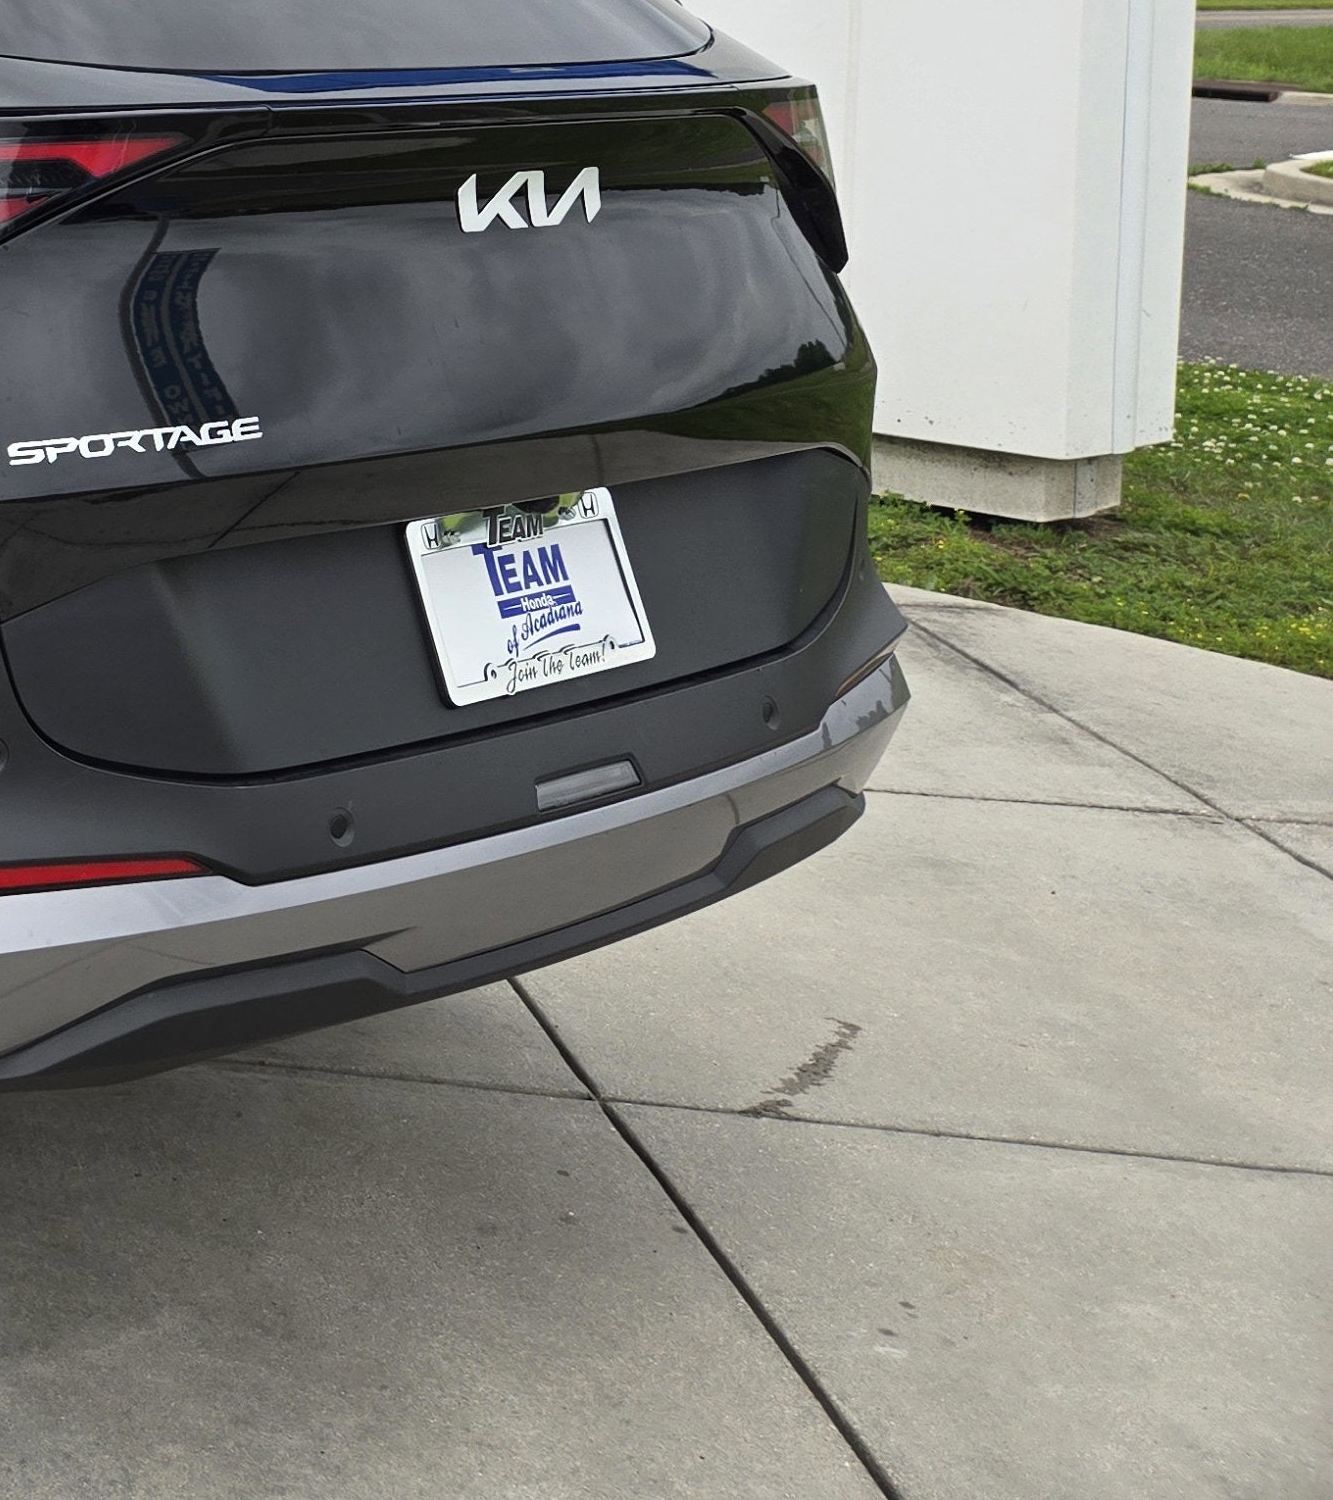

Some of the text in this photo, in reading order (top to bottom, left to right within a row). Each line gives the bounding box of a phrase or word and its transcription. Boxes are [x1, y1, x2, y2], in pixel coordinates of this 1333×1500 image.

[458, 166, 602, 233] KIA
[7, 416, 264, 466] SPORTAGE
[482, 506, 545, 546] TEAM
[471, 543, 569, 597] TEAM
[521, 593, 554, 612] Honda
[507, 601, 584, 658] of Acadiana
